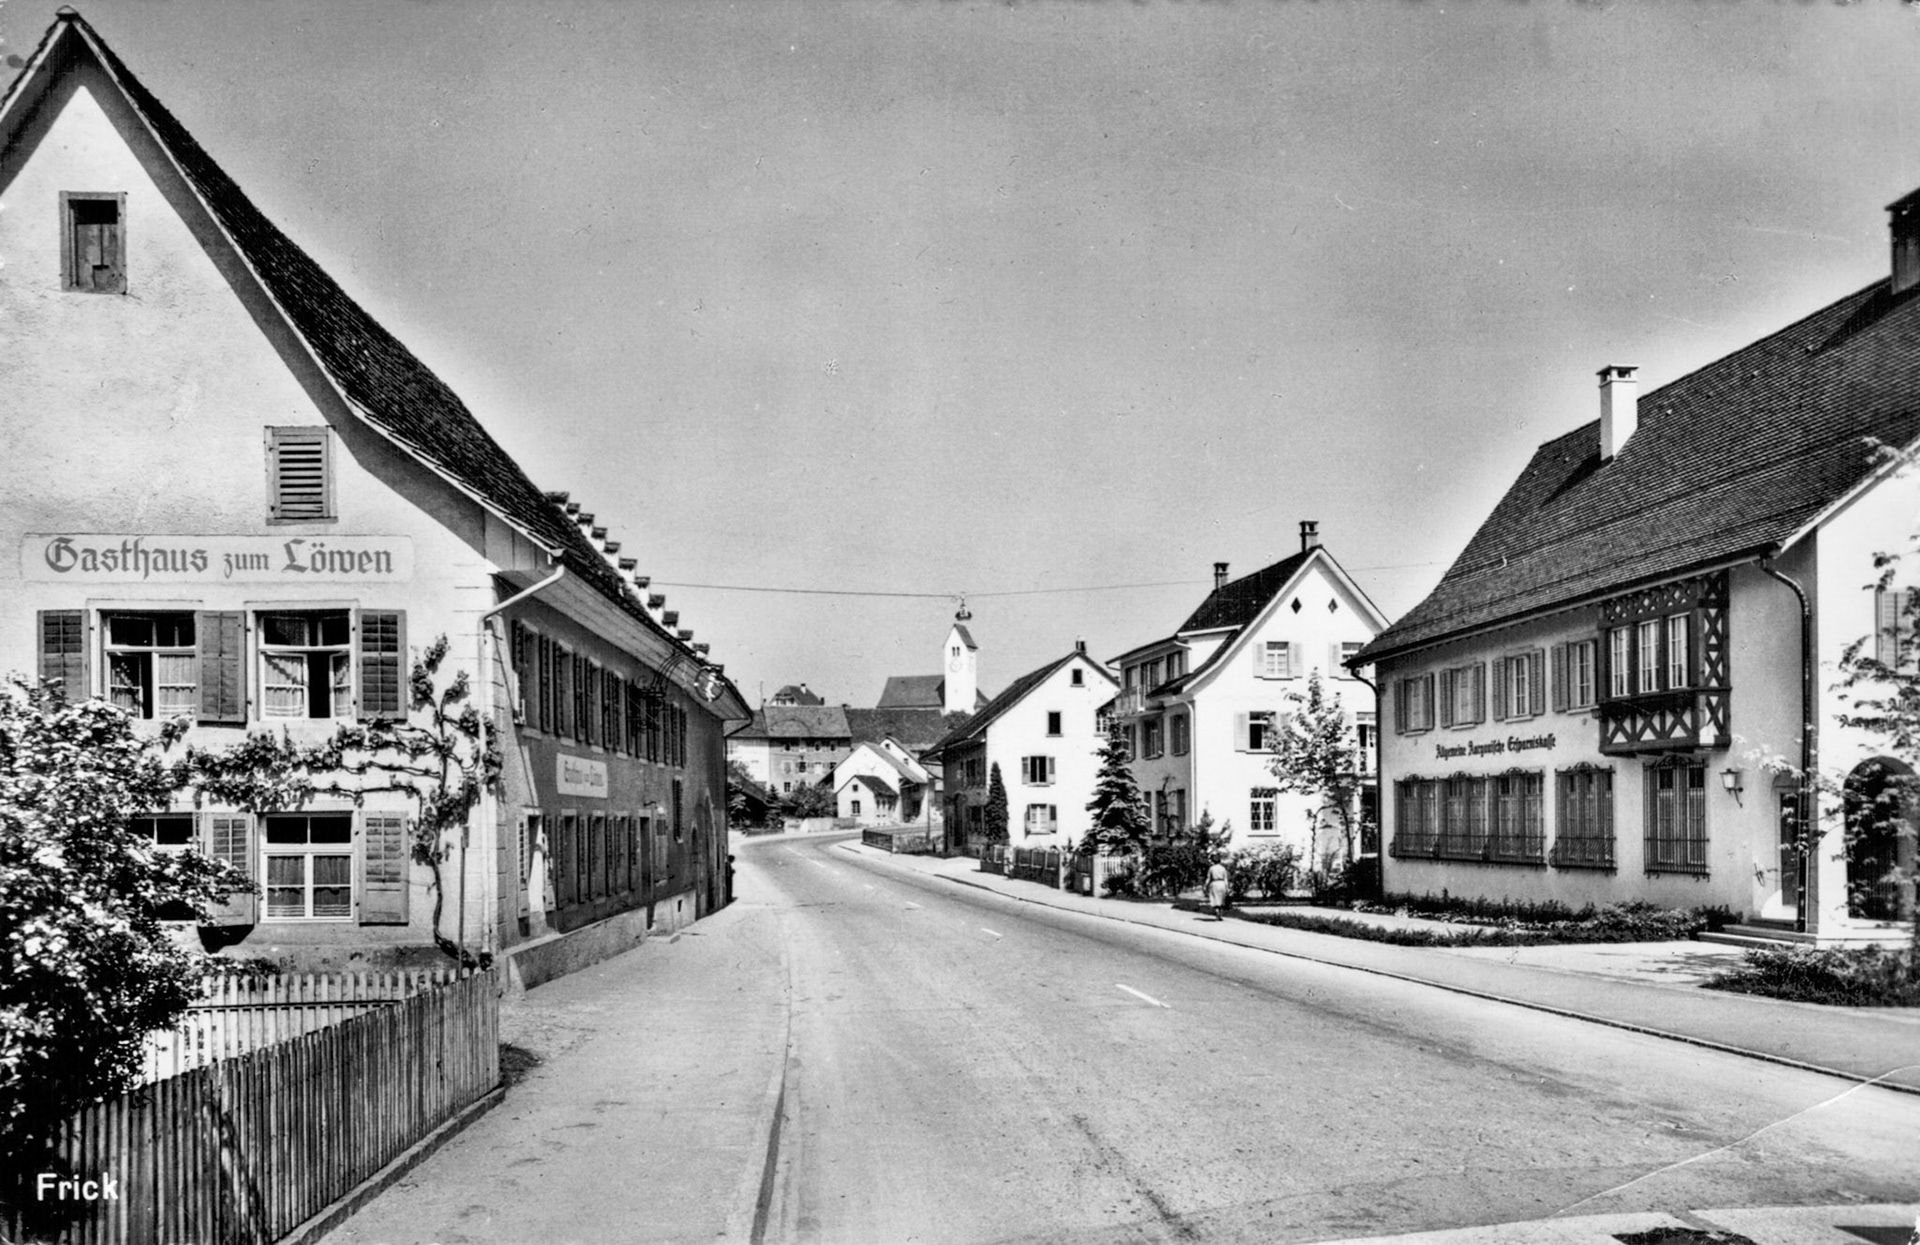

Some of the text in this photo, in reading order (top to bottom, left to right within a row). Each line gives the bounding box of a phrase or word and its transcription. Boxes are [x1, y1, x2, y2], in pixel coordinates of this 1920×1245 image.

[44, 536, 394, 580] Gasthaus zum Löwen
